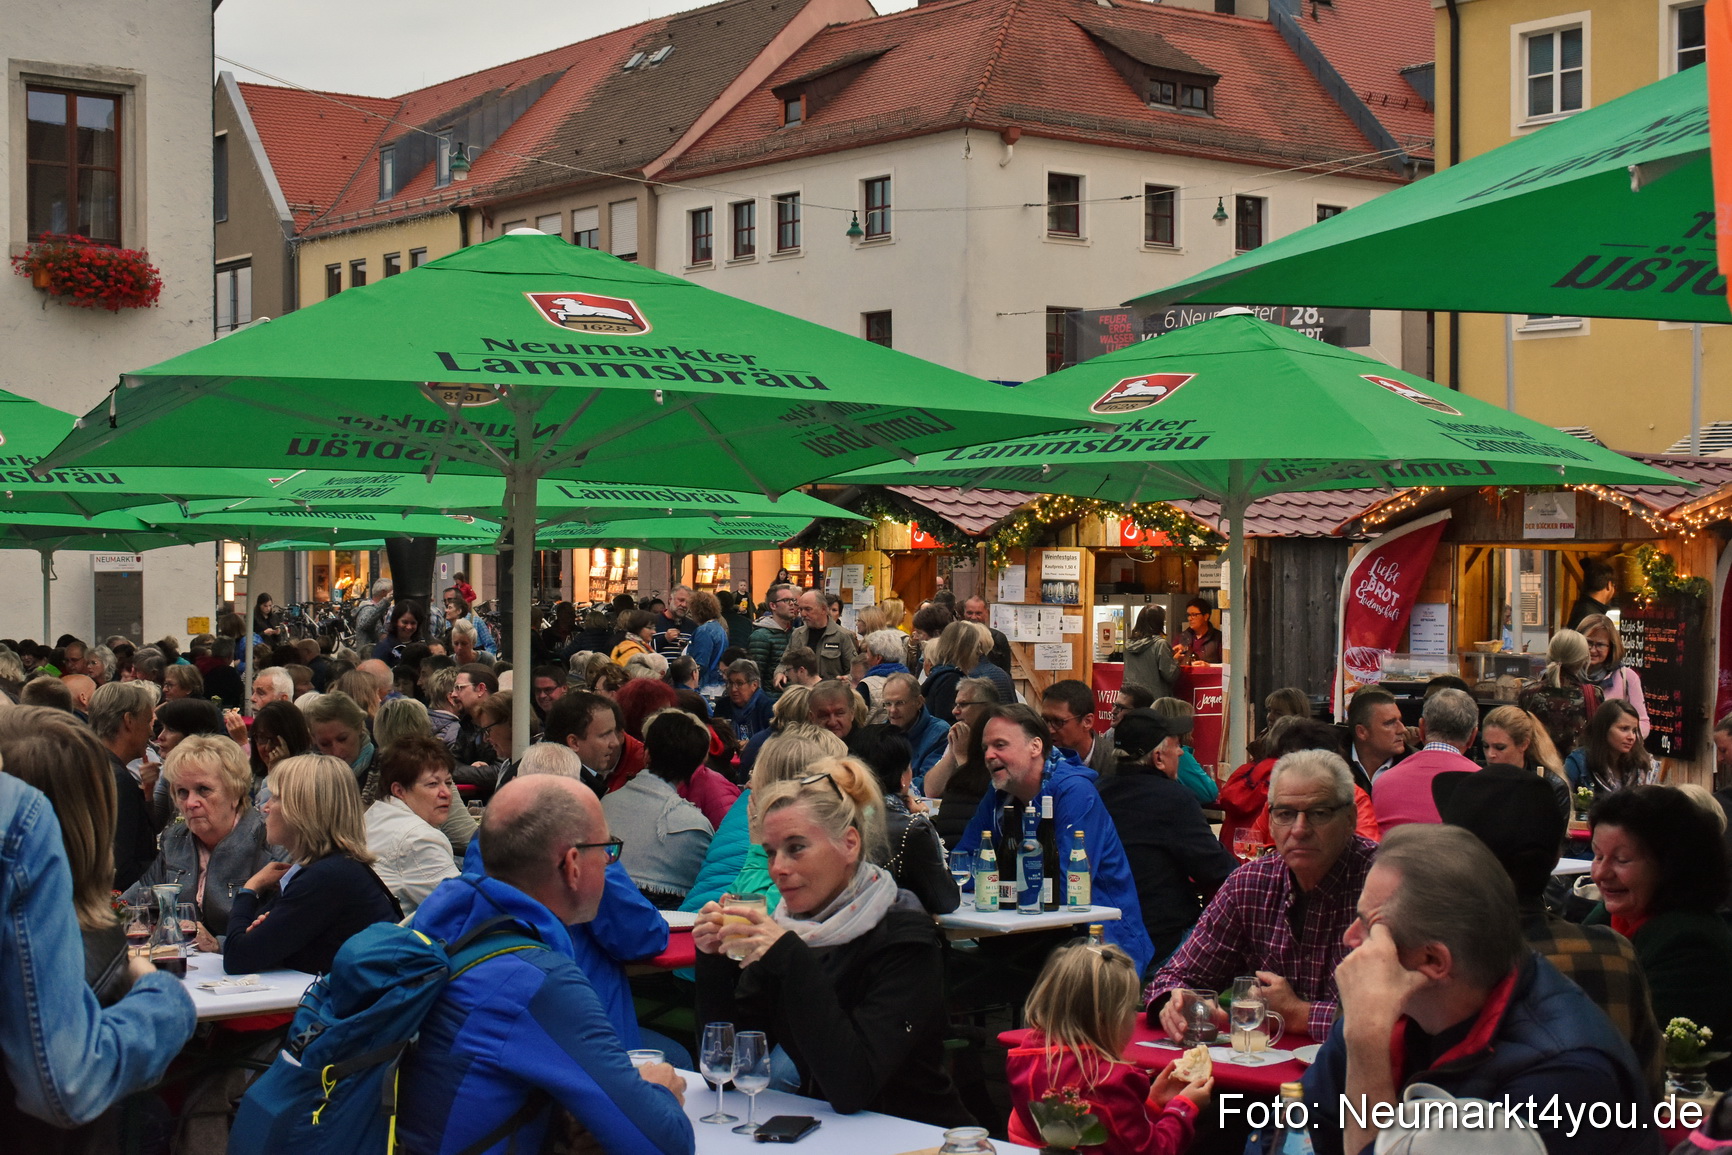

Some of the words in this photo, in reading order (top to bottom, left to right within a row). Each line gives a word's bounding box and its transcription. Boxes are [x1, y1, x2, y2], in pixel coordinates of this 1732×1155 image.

[1099, 314, 1128, 325] FEUER
[1290, 306, 1324, 326] 28.
[582, 324, 628, 332] 1628
[1108, 323, 1132, 334] ERDE
[1293, 328, 1324, 342] PT.
[1100, 333, 1135, 344] WASSER
[480, 337, 757, 366] Neumarkter
[434, 352, 831, 391] Lammsbräu
[1103, 403, 1138, 411] 1628
[943, 432, 1211, 462] Lammsbräu
[556, 485, 740, 505] Lammsbräu
[1367, 576, 1400, 606] BROT
[1097, 689, 1120, 704] Will
